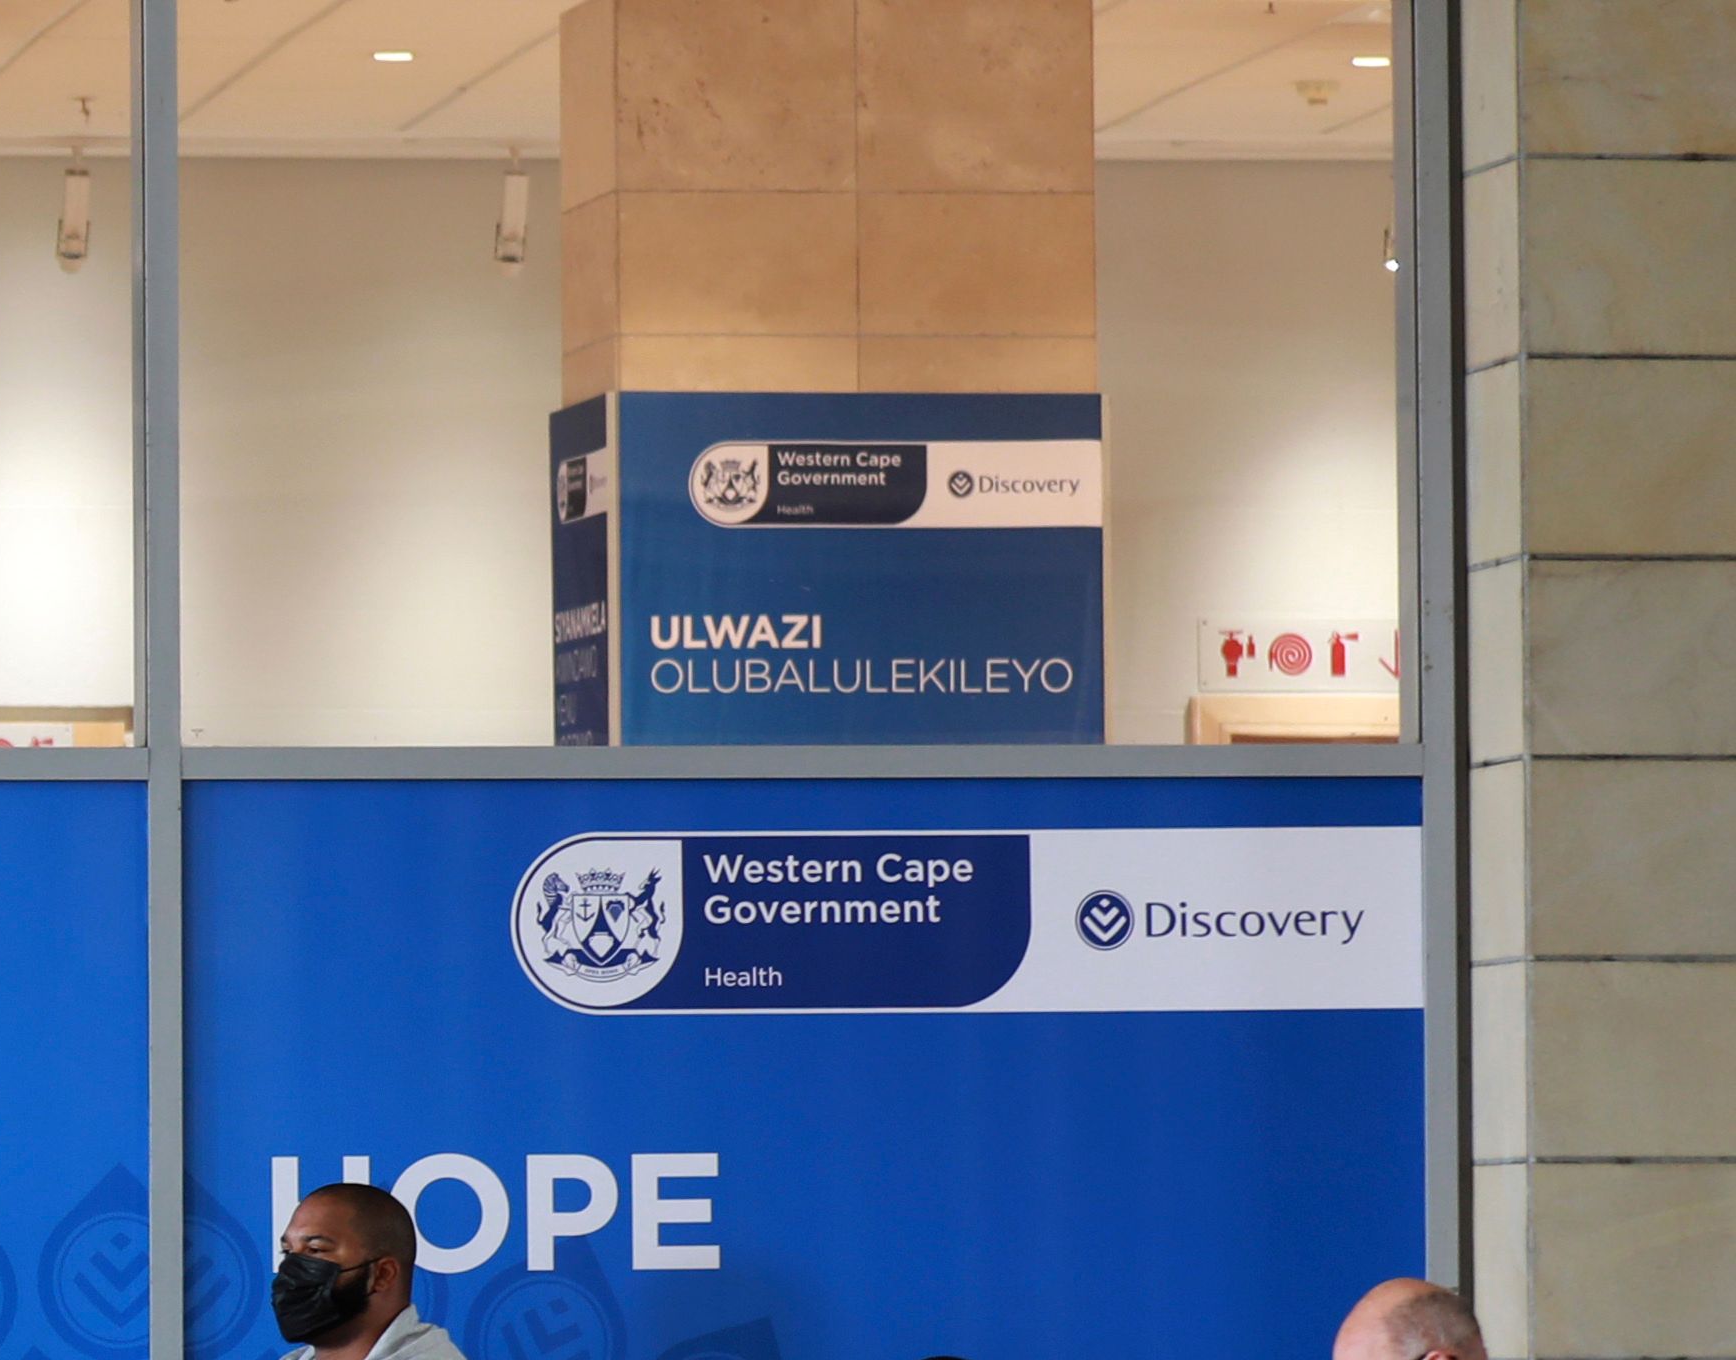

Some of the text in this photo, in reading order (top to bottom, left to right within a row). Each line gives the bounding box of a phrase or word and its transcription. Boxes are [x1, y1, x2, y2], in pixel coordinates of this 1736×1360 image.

[776, 450, 902, 470] Western Cape
[776, 470, 887, 487] Government
[978, 474, 1081, 497] Discovery
[776, 503, 815, 516] Health
[650, 614, 823, 650] ULWAZI
[650, 657, 1074, 694] OLUBALULEKILEYO
[702, 853, 974, 888] Western Cape
[703, 894, 941, 925] Government
[1143, 899, 1366, 945] Discovery
[704, 966, 783, 987] Health
